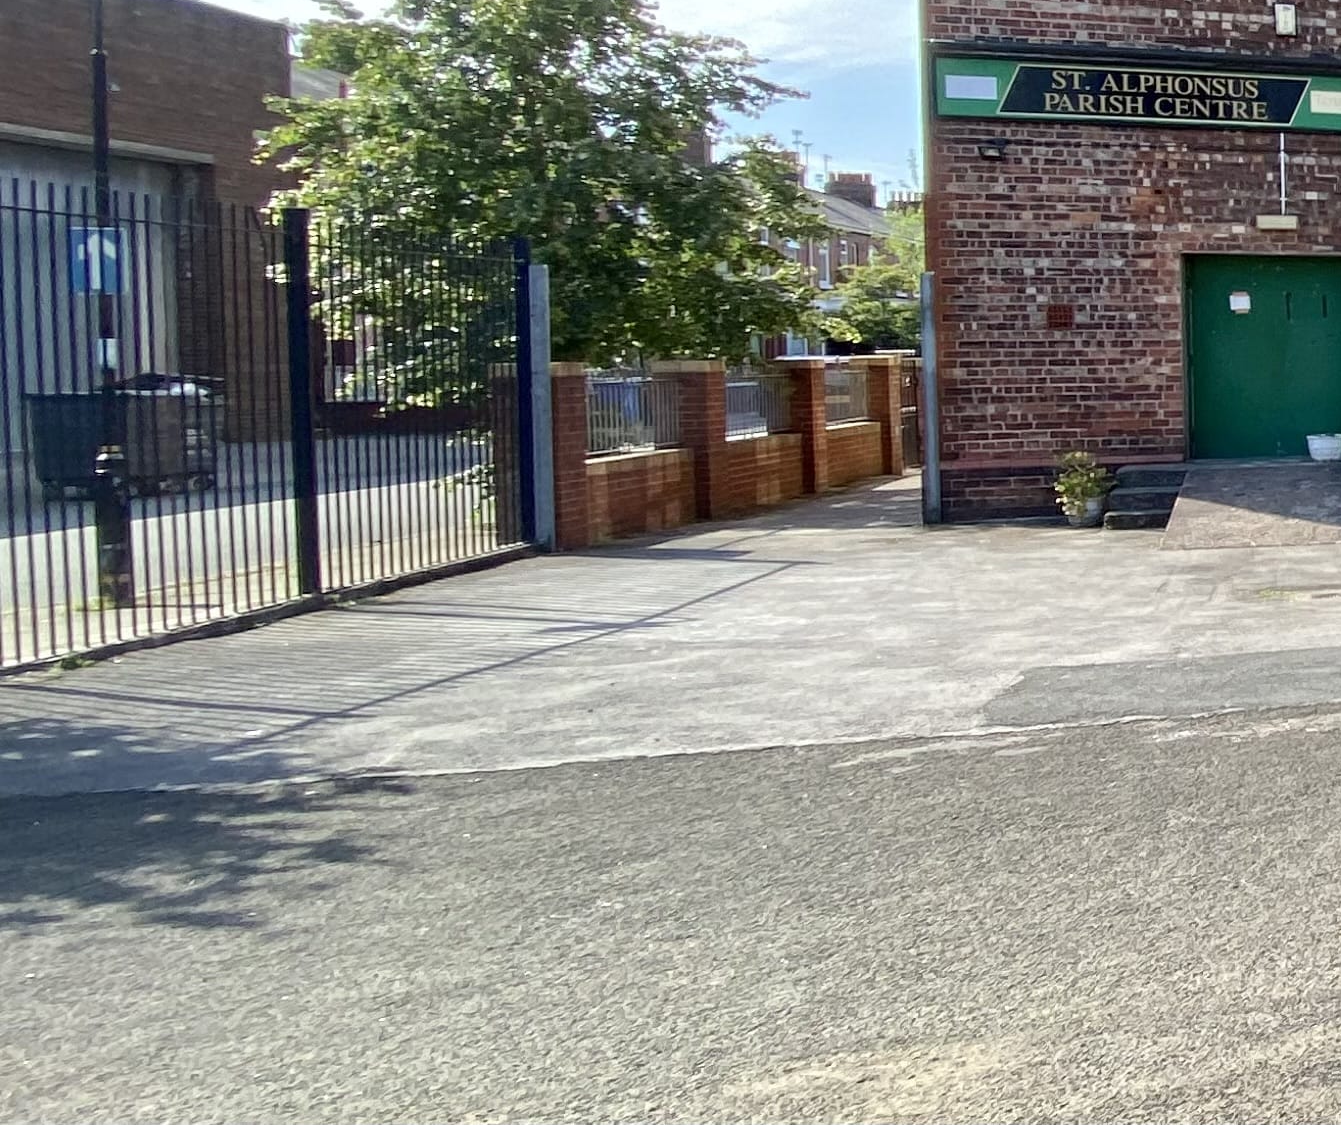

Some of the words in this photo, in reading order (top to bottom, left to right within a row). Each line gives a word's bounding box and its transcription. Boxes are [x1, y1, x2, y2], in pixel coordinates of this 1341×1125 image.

[1051, 69, 1091, 91] ST.
[1101, 73, 1259, 99] ALPHONSUS
[1043, 92, 1144, 115] PARISH
[1155, 96, 1269, 121] CENTRE
